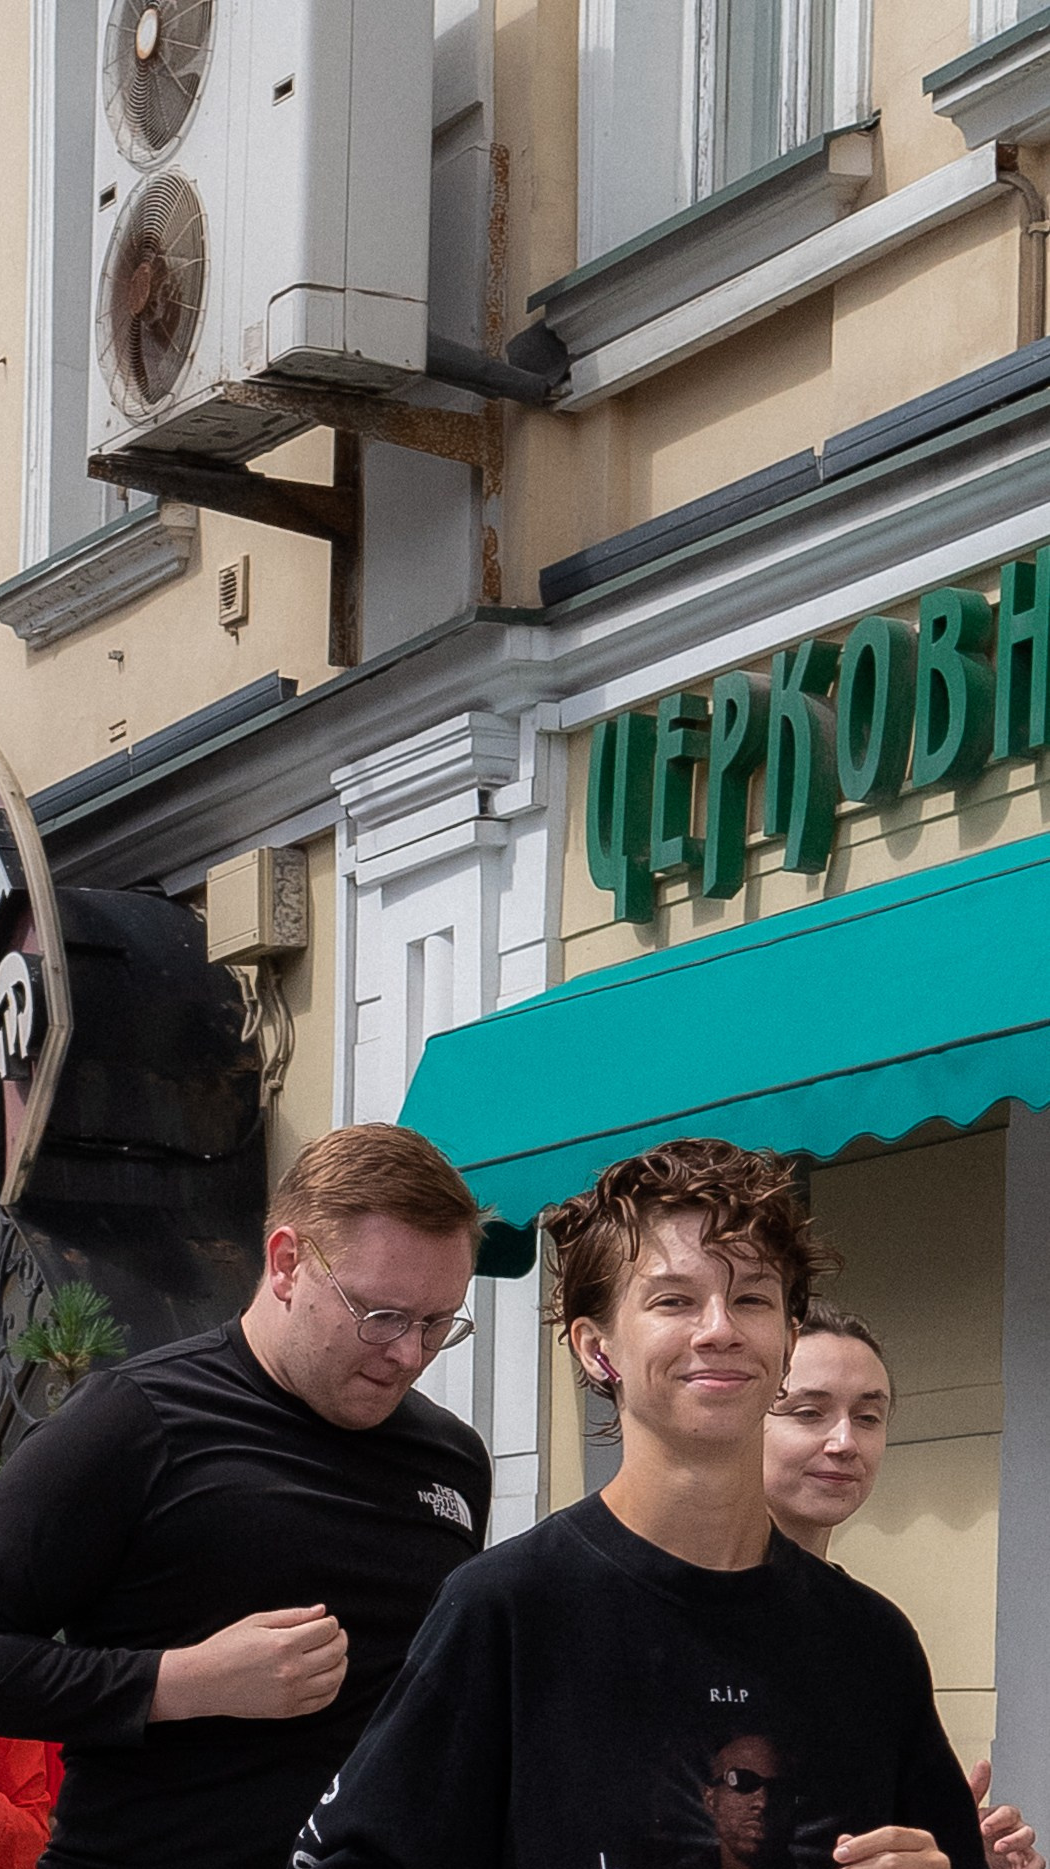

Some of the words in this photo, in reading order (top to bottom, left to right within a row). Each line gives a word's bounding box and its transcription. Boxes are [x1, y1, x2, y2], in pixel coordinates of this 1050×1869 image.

[587, 546, 1050, 924] ЦЕРКОВН
[432, 1483, 453, 1497] THE
[417, 1490, 458, 1511] NORTH
[433, 1504, 462, 1524] FACE
